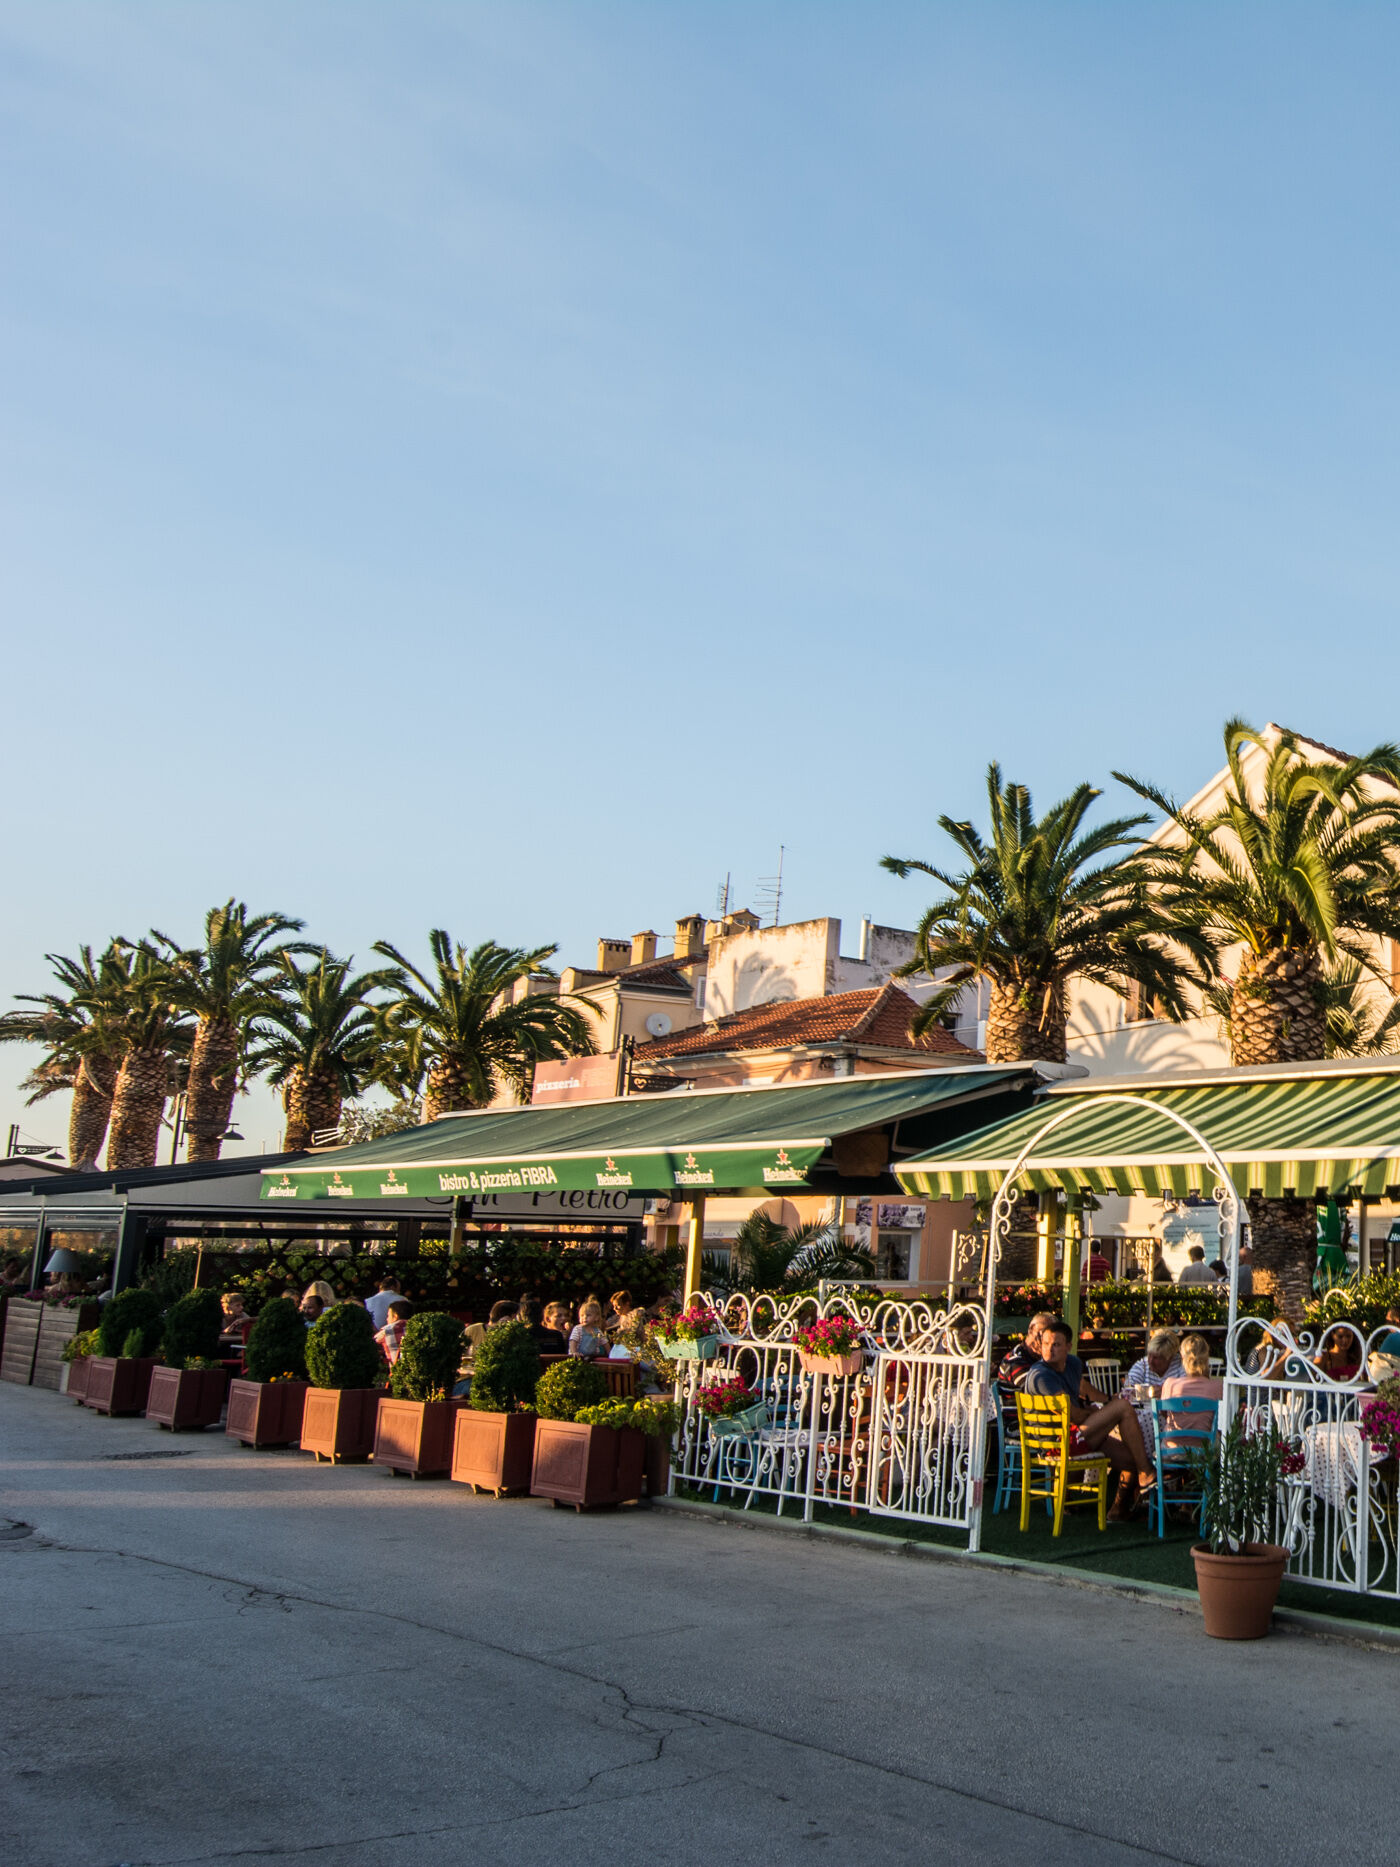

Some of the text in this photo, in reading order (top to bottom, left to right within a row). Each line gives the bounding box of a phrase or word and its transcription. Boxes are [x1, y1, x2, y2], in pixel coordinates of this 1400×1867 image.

[536, 1077, 580, 1094] pizzeria
[438, 1165, 558, 1192] bistro & pizzeria FIBRA
[595, 1171, 633, 1186] Heineken
[674, 1169, 714, 1184] Heineken
